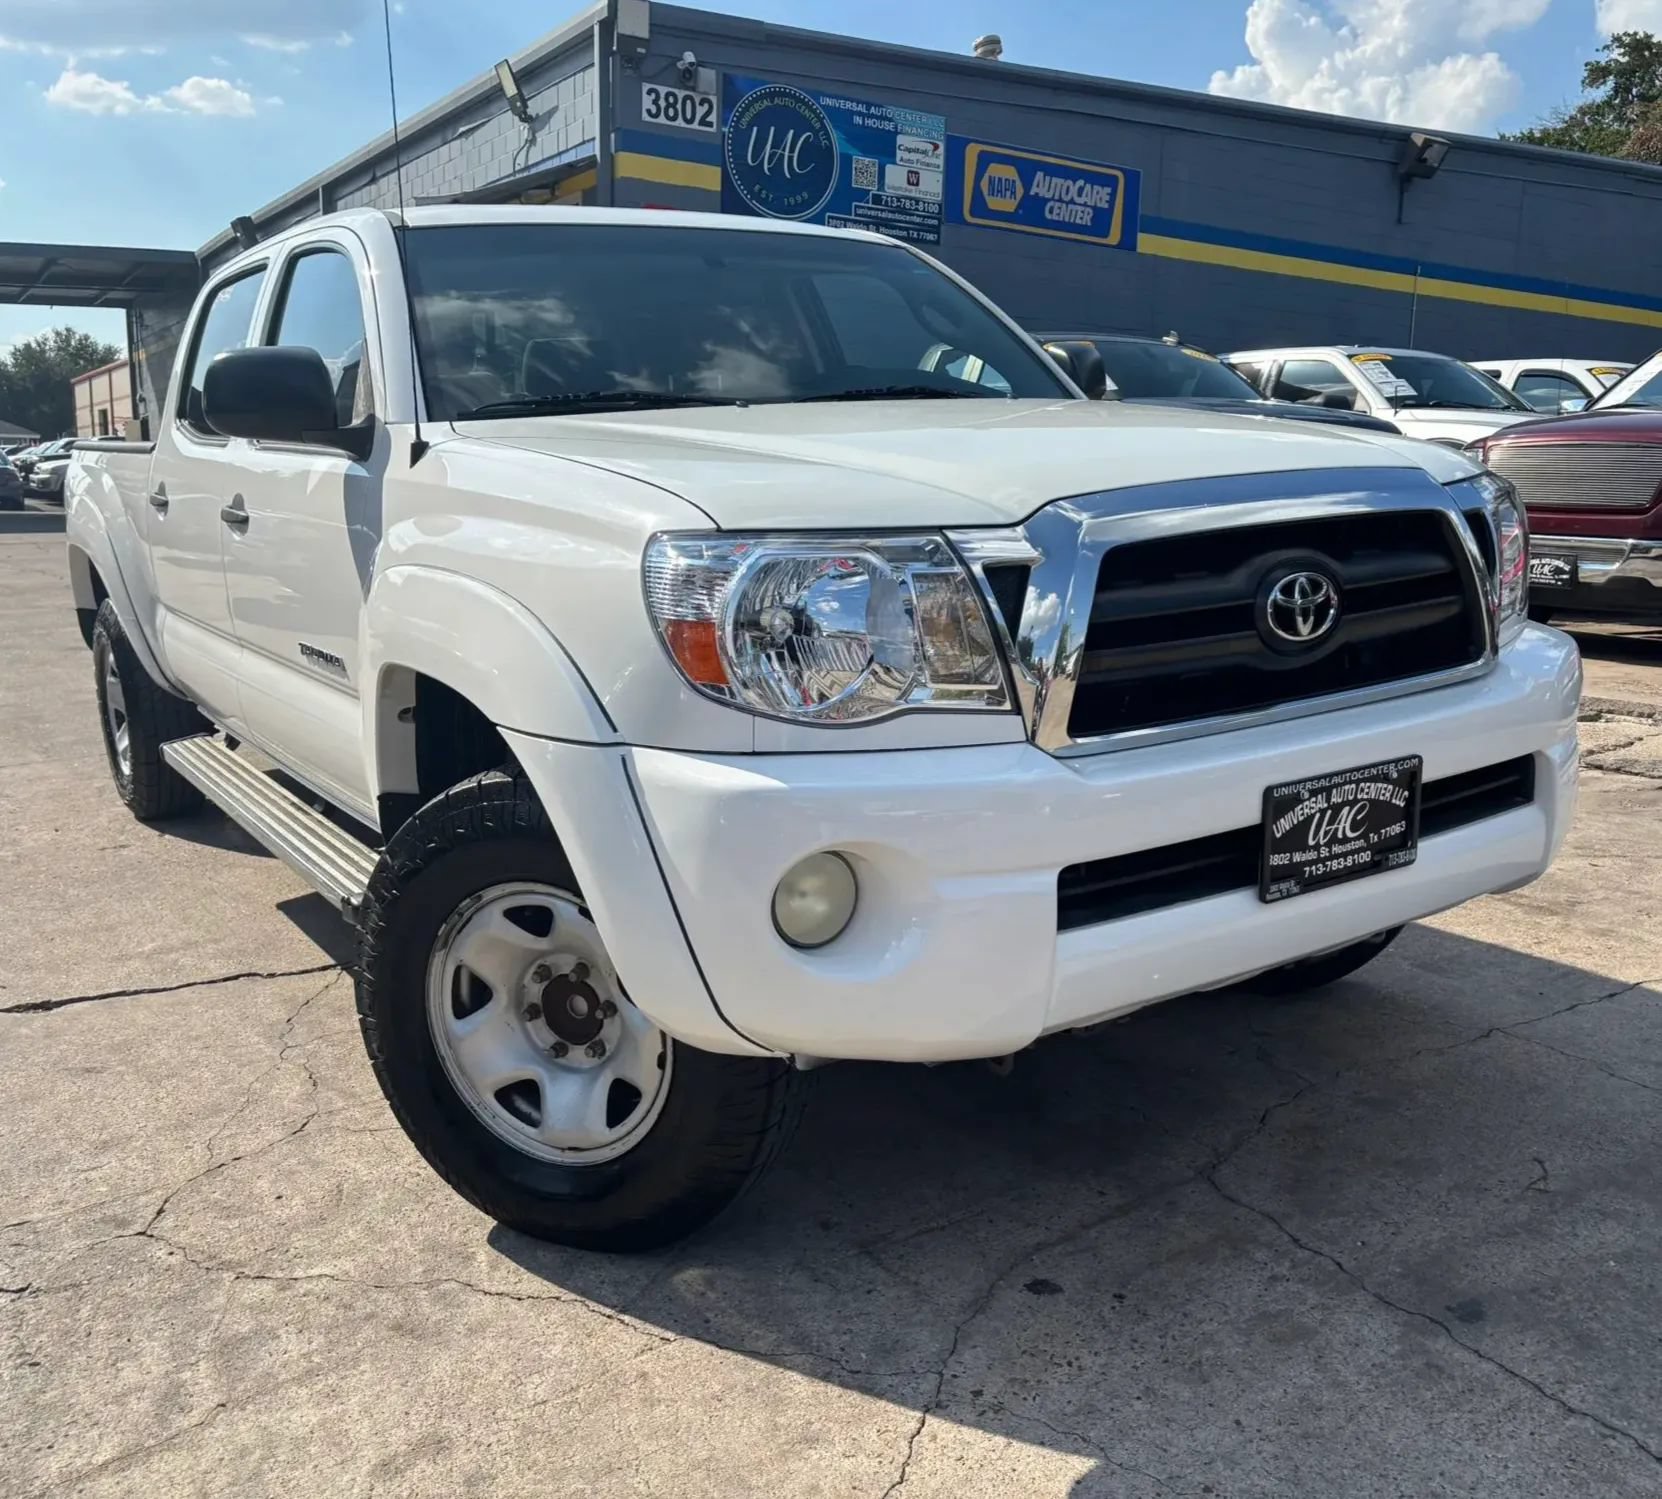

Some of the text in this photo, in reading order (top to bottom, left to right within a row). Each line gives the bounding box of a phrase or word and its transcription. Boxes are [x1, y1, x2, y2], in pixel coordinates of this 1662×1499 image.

[646, 87, 714, 129] 3802
[820, 96, 869, 114] UNIVERSAL
[869, 107, 894, 118] AUTO
[895, 111, 927, 124] CENTER
[738, 96, 830, 149] UNIVERSAL AUTO CENTER LLC
[853, 115, 944, 140] IN HOUSE FINANCING
[747, 126, 816, 179] UAC
[908, 171, 919, 185] W
[988, 174, 1017, 200] NAPA
[784, 191, 809, 206] 1999
[881, 196, 939, 213] 713-783-8100
[856, 207, 939, 225] universalautocenter.com
[1044, 200, 1094, 226] CENTER
[879, 225, 908, 237] Houston
[909, 230, 919, 239] TX
[1273, 758, 1419, 797] UNIVERSALAUTOCENTER.COM
[1272, 782, 1409, 838] UNIVERSAL AUTO CENTER LLC
[1308, 800, 1369, 846] UAC
[1292, 849, 1318, 862] Waldo
[1320, 846, 1330, 857] St
[1332, 839, 1367, 855] Houston,
[1369, 832, 1379, 844] Tx
[1380, 820, 1406, 839] 77063
[1303, 850, 1371, 878] 713-783-8100
